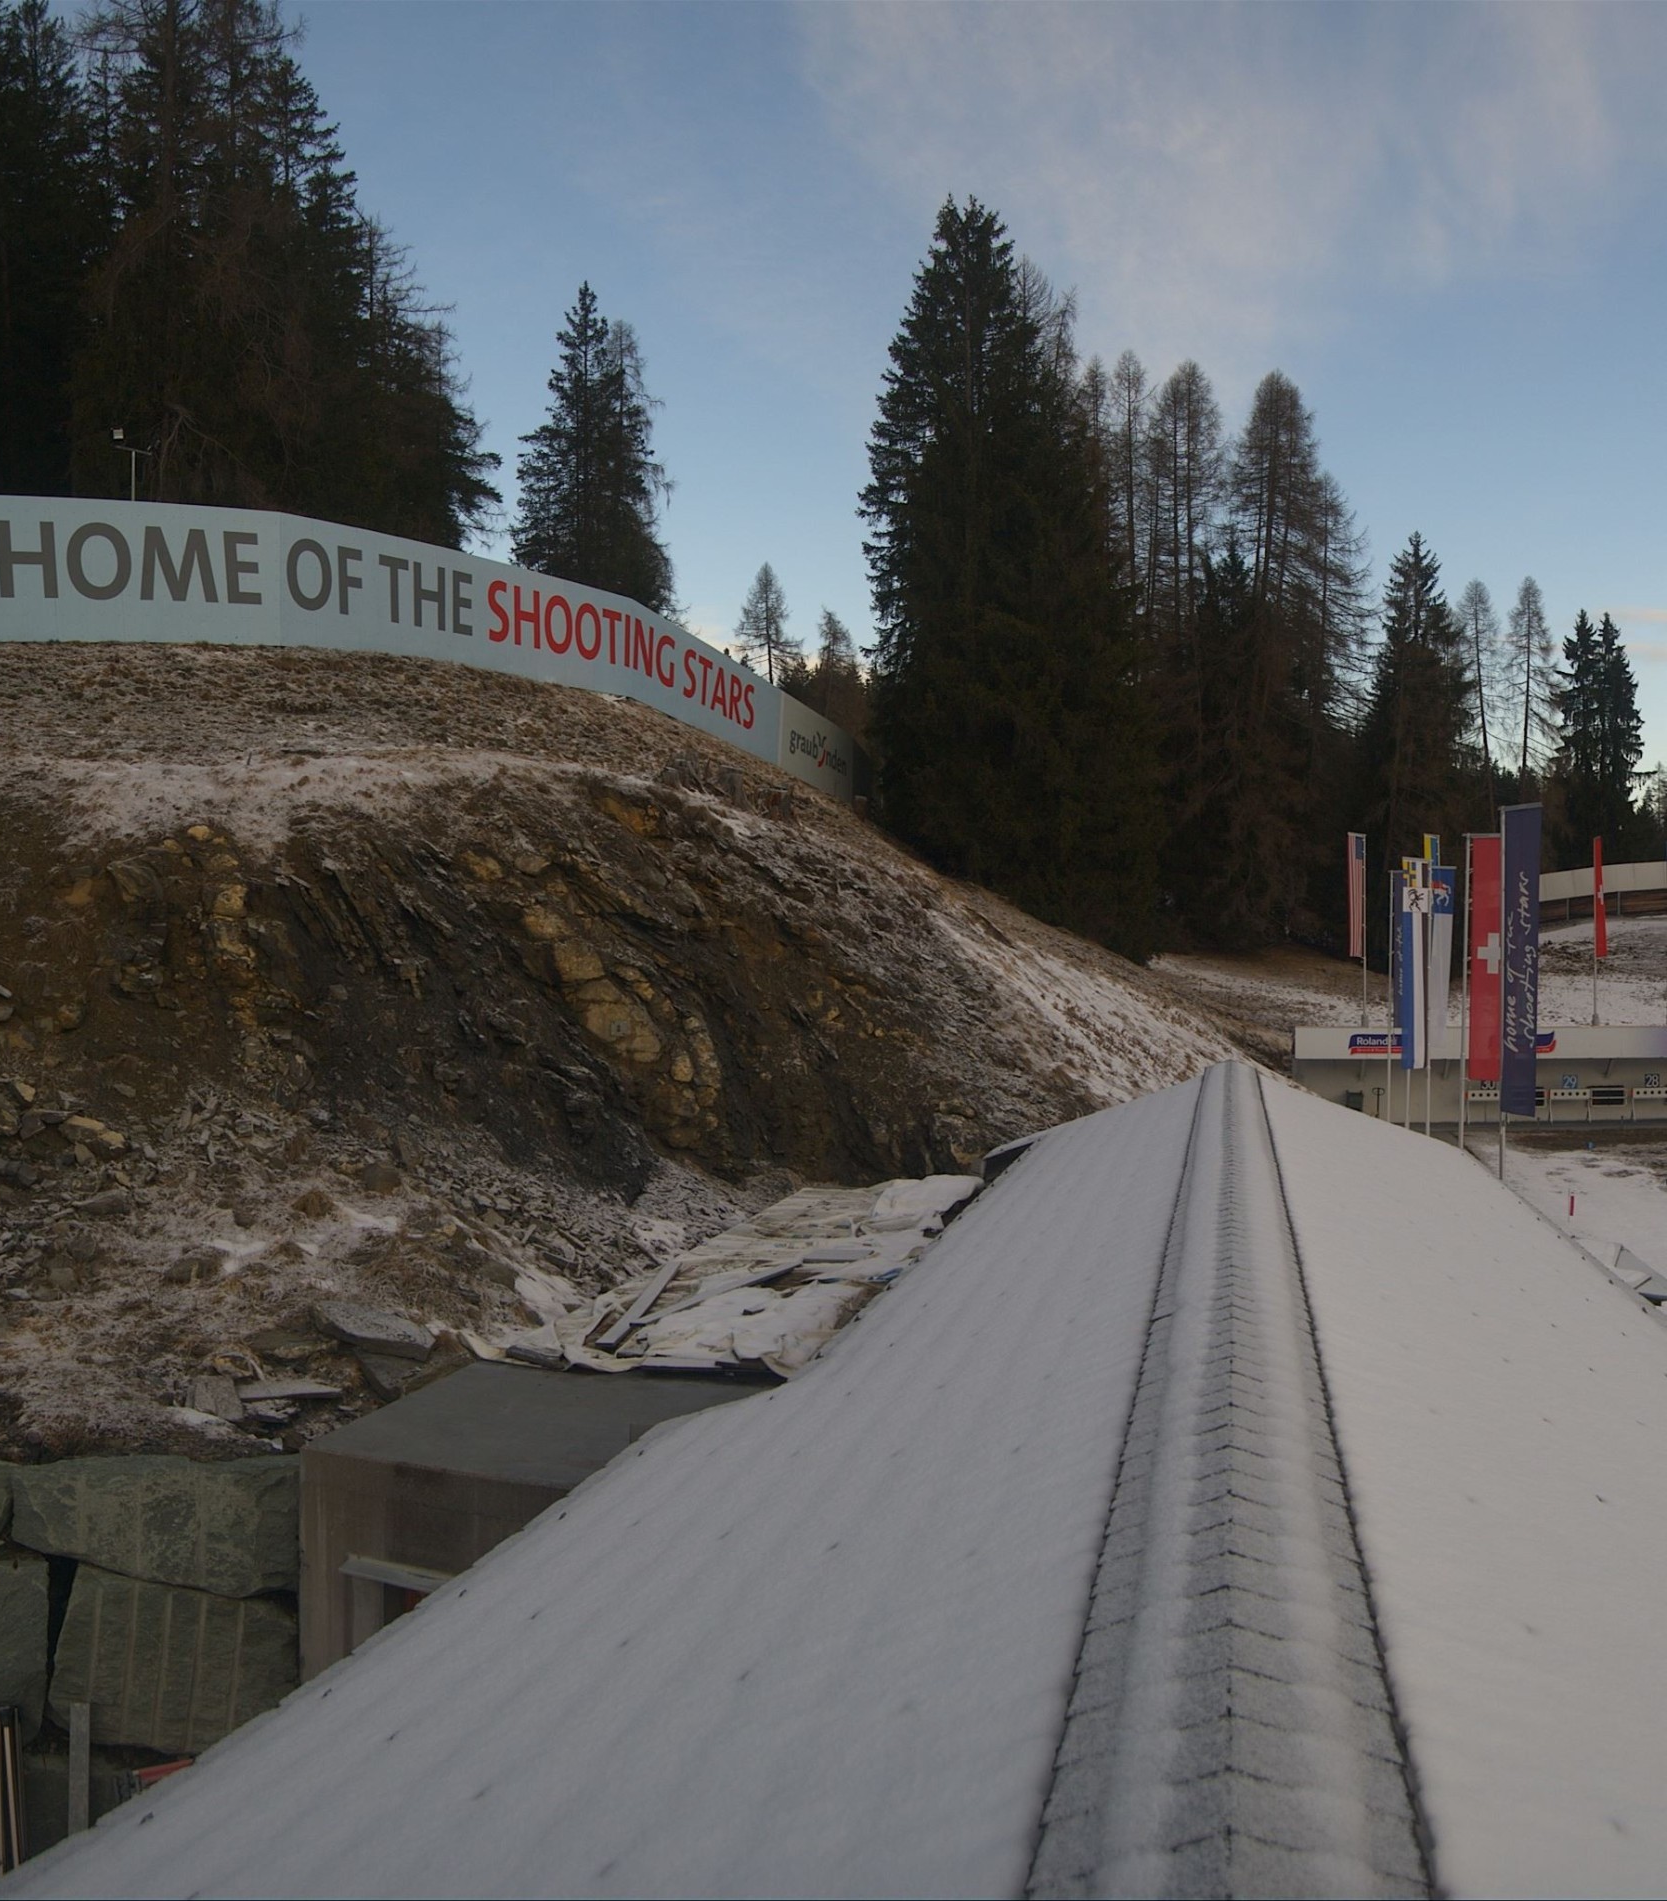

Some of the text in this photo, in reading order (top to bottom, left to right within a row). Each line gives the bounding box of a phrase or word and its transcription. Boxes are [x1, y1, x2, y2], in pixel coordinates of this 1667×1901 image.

[286, 538, 363, 615] OF
[378, 554, 474, 636] THE
[487, 580, 676, 687] SHOOTING
[683, 649, 756, 730] STARS
[1356, 1037, 1390, 1047] Roland
[1563, 1077, 1577, 1089] 29
[1645, 1075, 1660, 1088] 28
